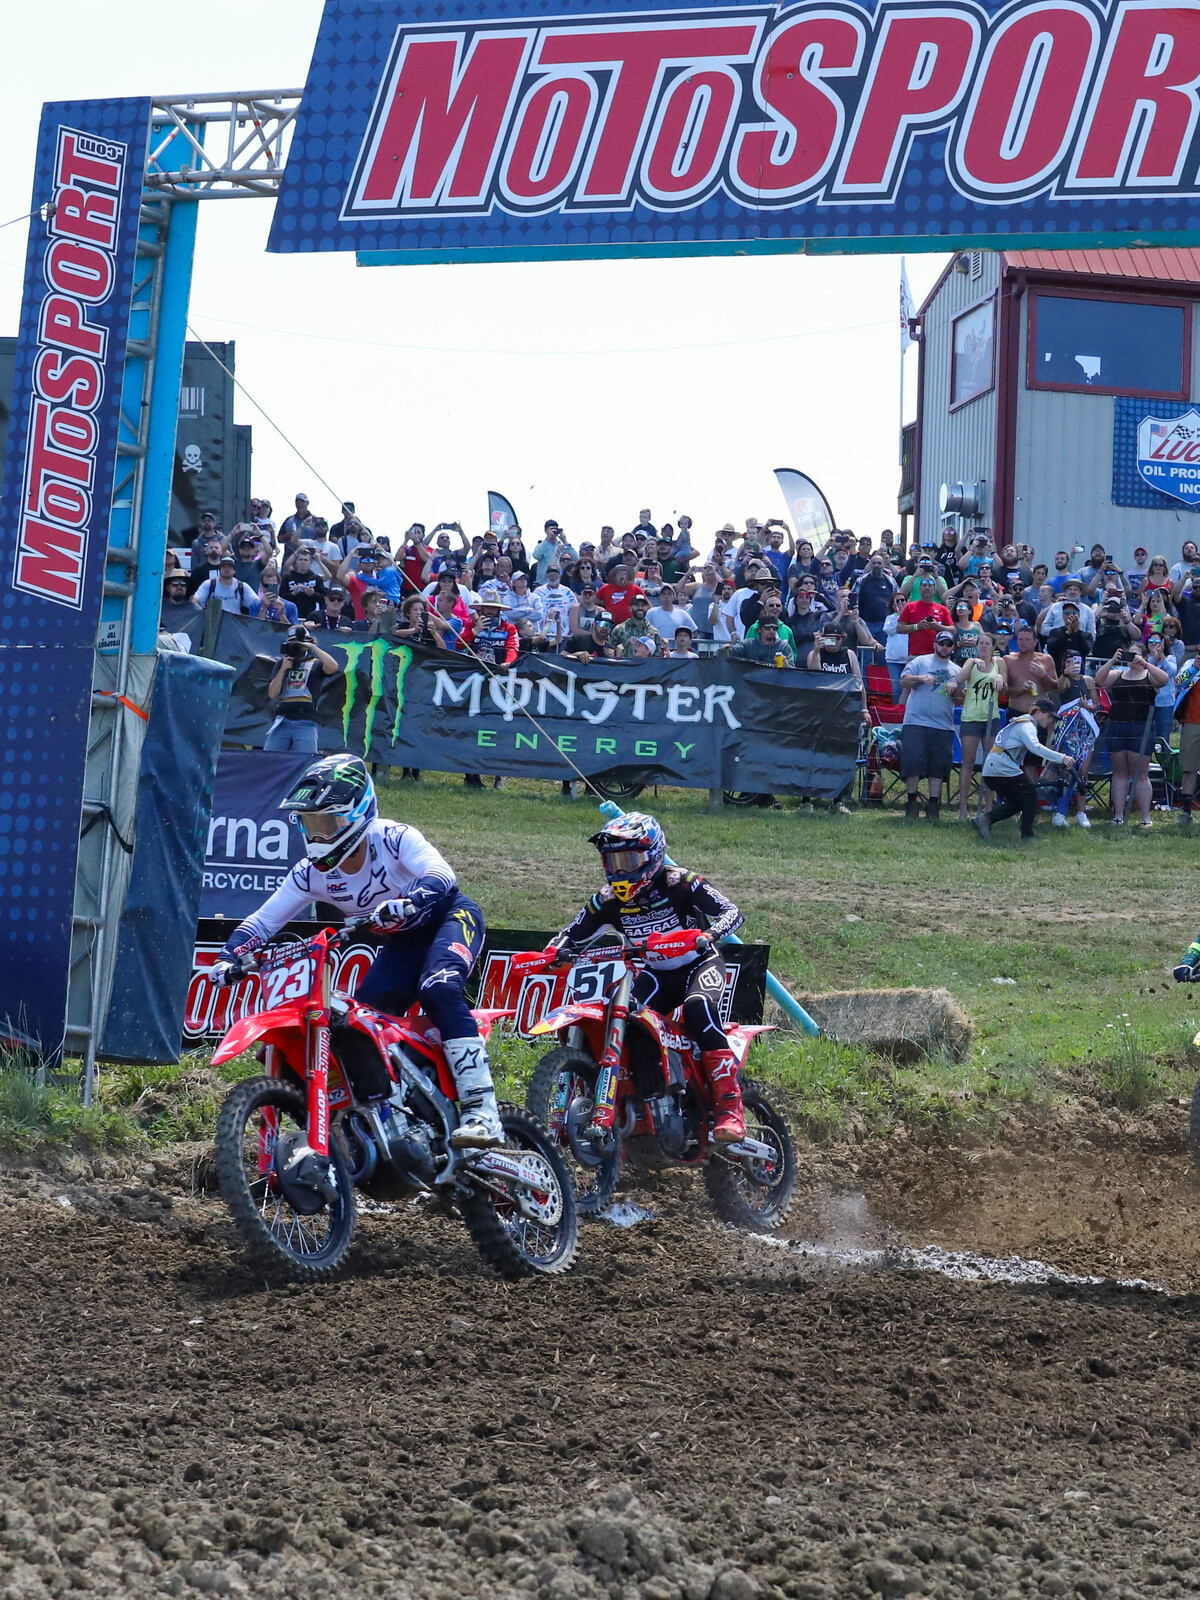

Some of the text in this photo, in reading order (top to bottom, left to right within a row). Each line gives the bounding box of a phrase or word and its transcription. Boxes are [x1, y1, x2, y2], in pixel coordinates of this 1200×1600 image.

[1143, 465, 1166, 477] OIL
[432, 668, 742, 730] MONSTER
[477, 730, 696, 759] ENERGY
[625, 918, 680, 937] GASGAS
[233, 935, 262, 957] HONDA
[587, 949, 620, 958] RENTHAL
[653, 941, 686, 950] ACERBIS
[514, 958, 546, 970] ACERBIS
[266, 959, 316, 1011] 23
[572, 961, 615, 1001] 51
[600, 1068, 611, 1103] DUNLOP
[317, 1088, 328, 1146] DUNLOP
[488, 1158, 520, 1174] ENTHAL
